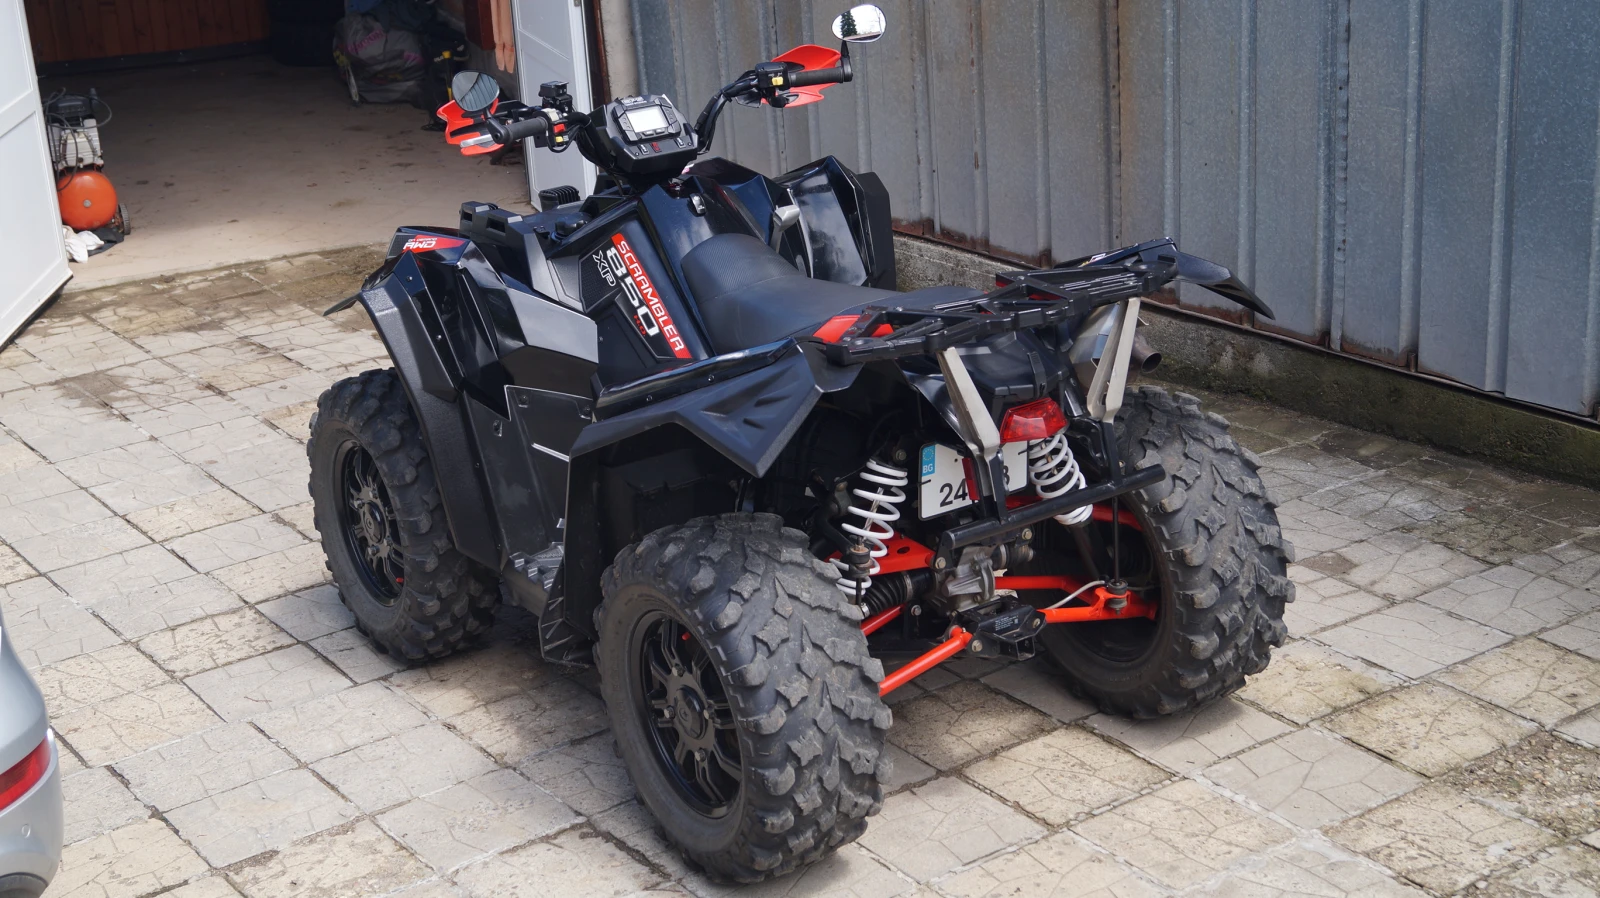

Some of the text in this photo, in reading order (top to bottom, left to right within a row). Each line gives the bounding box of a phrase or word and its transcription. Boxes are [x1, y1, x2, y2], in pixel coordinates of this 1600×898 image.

[403, 241, 436, 250] AWD
[592, 250, 616, 286] XP
[606, 247, 660, 336] 850
[618, 241, 685, 351] SCRAMBLER
[923, 463, 933, 473] BG
